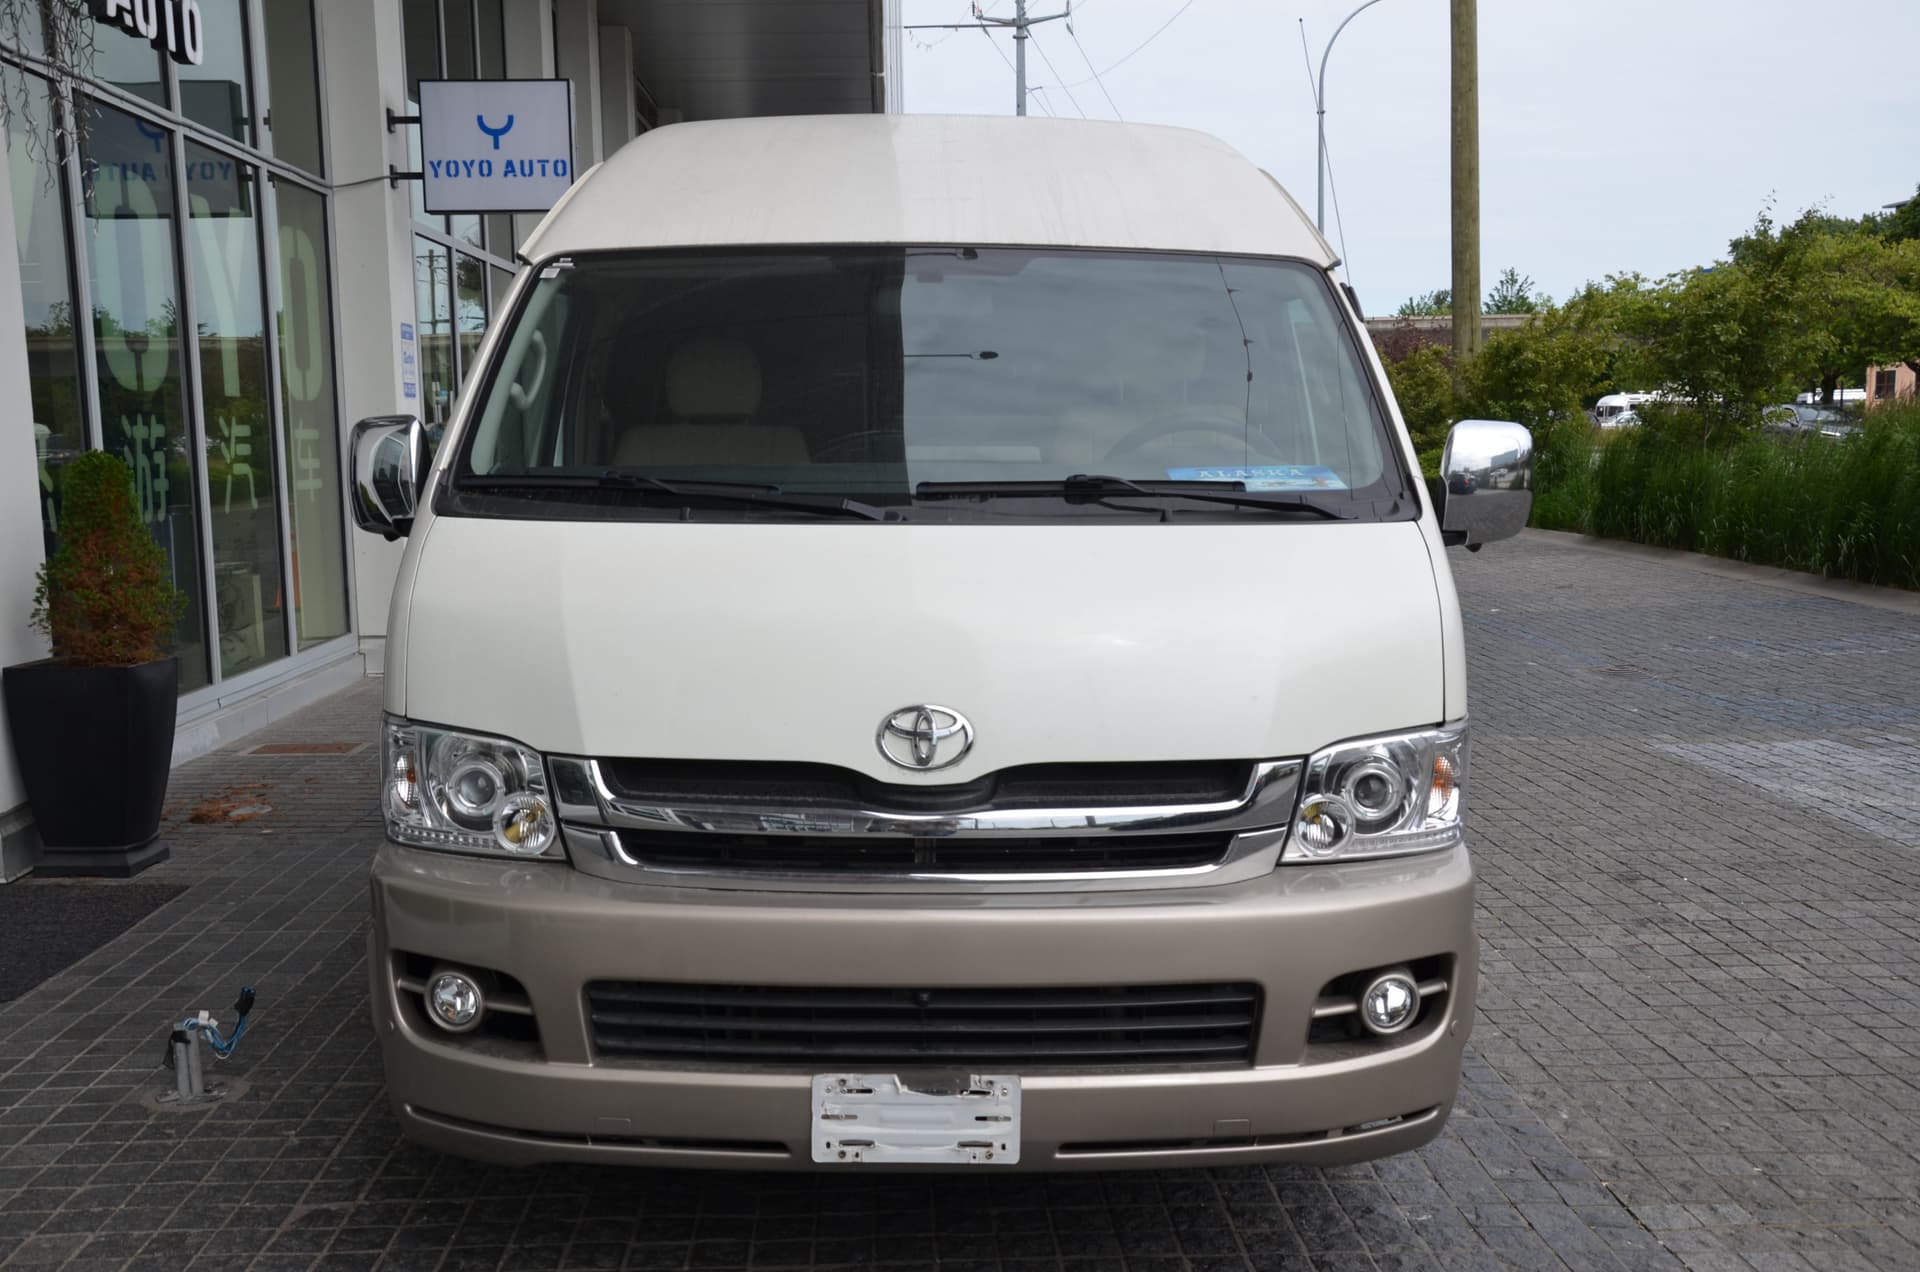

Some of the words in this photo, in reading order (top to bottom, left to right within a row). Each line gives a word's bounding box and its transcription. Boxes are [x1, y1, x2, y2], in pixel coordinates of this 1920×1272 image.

[429, 159, 492, 178] YOYO
[503, 159, 567, 178] AUTO
[1199, 468, 1304, 478] ALASKA
